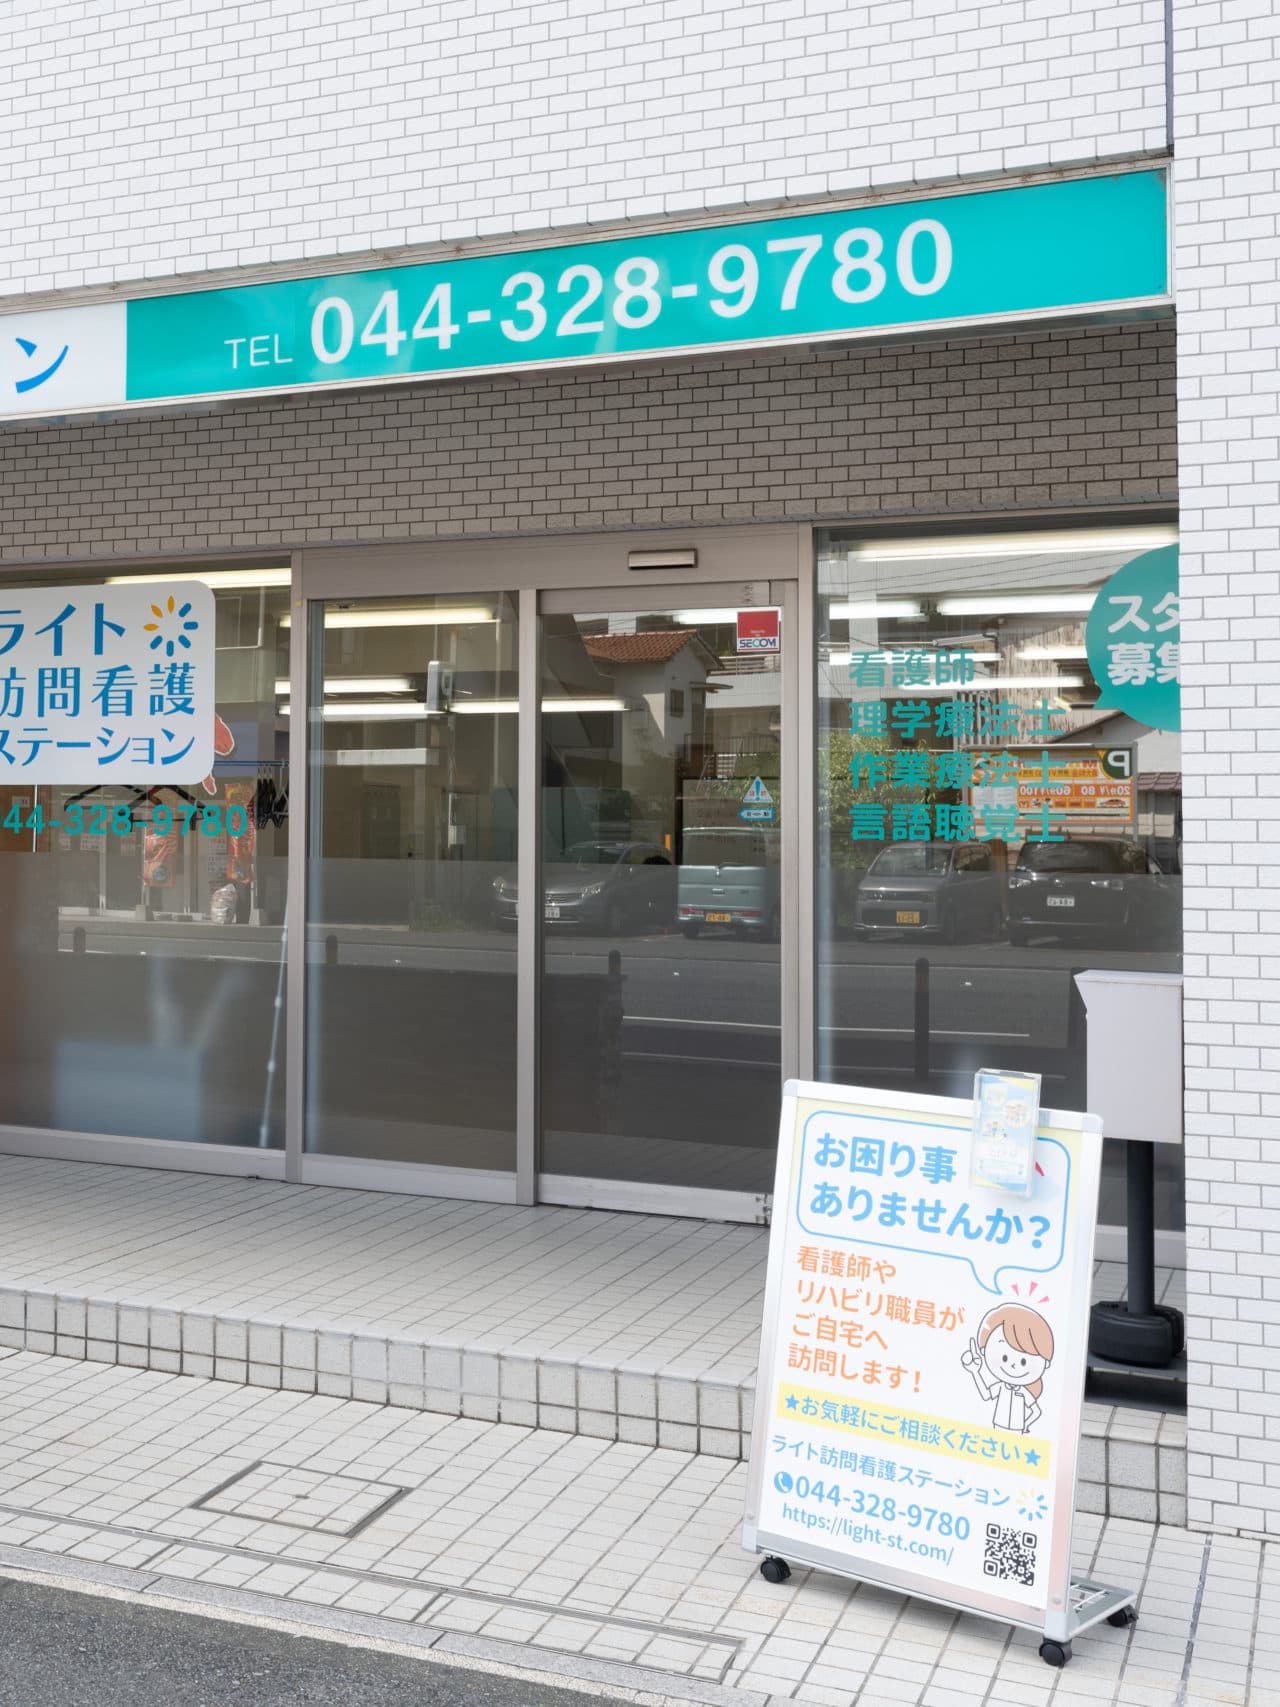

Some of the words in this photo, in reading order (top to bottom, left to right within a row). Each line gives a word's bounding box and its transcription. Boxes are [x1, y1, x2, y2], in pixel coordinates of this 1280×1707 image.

[224, 336, 292, 370] TEL
[309, 218, 954, 366] 044-328-9780
[739, 638, 776, 648] SECOM
[848, 648, 976, 689] 看護師
[848, 699, 1067, 739] 理学療法士
[848, 750, 1067, 790] 作業療法士
[848, 802, 1067, 843] 言語聴覚士
[814, 1132, 958, 1185] お困り事
[810, 1181, 1051, 1249] ありませんか?
[796, 1245, 897, 1284] 看護師や
[796, 1279, 965, 1331] リハビリ職員が
[792, 1312, 888, 1350] ご自宅へ
[771, 1435, 1011, 1508] ライト訪問看護ステーション
[795, 1475, 971, 1541] 044-328-9780
[782, 1503, 955, 1566] https://light-st.com/
